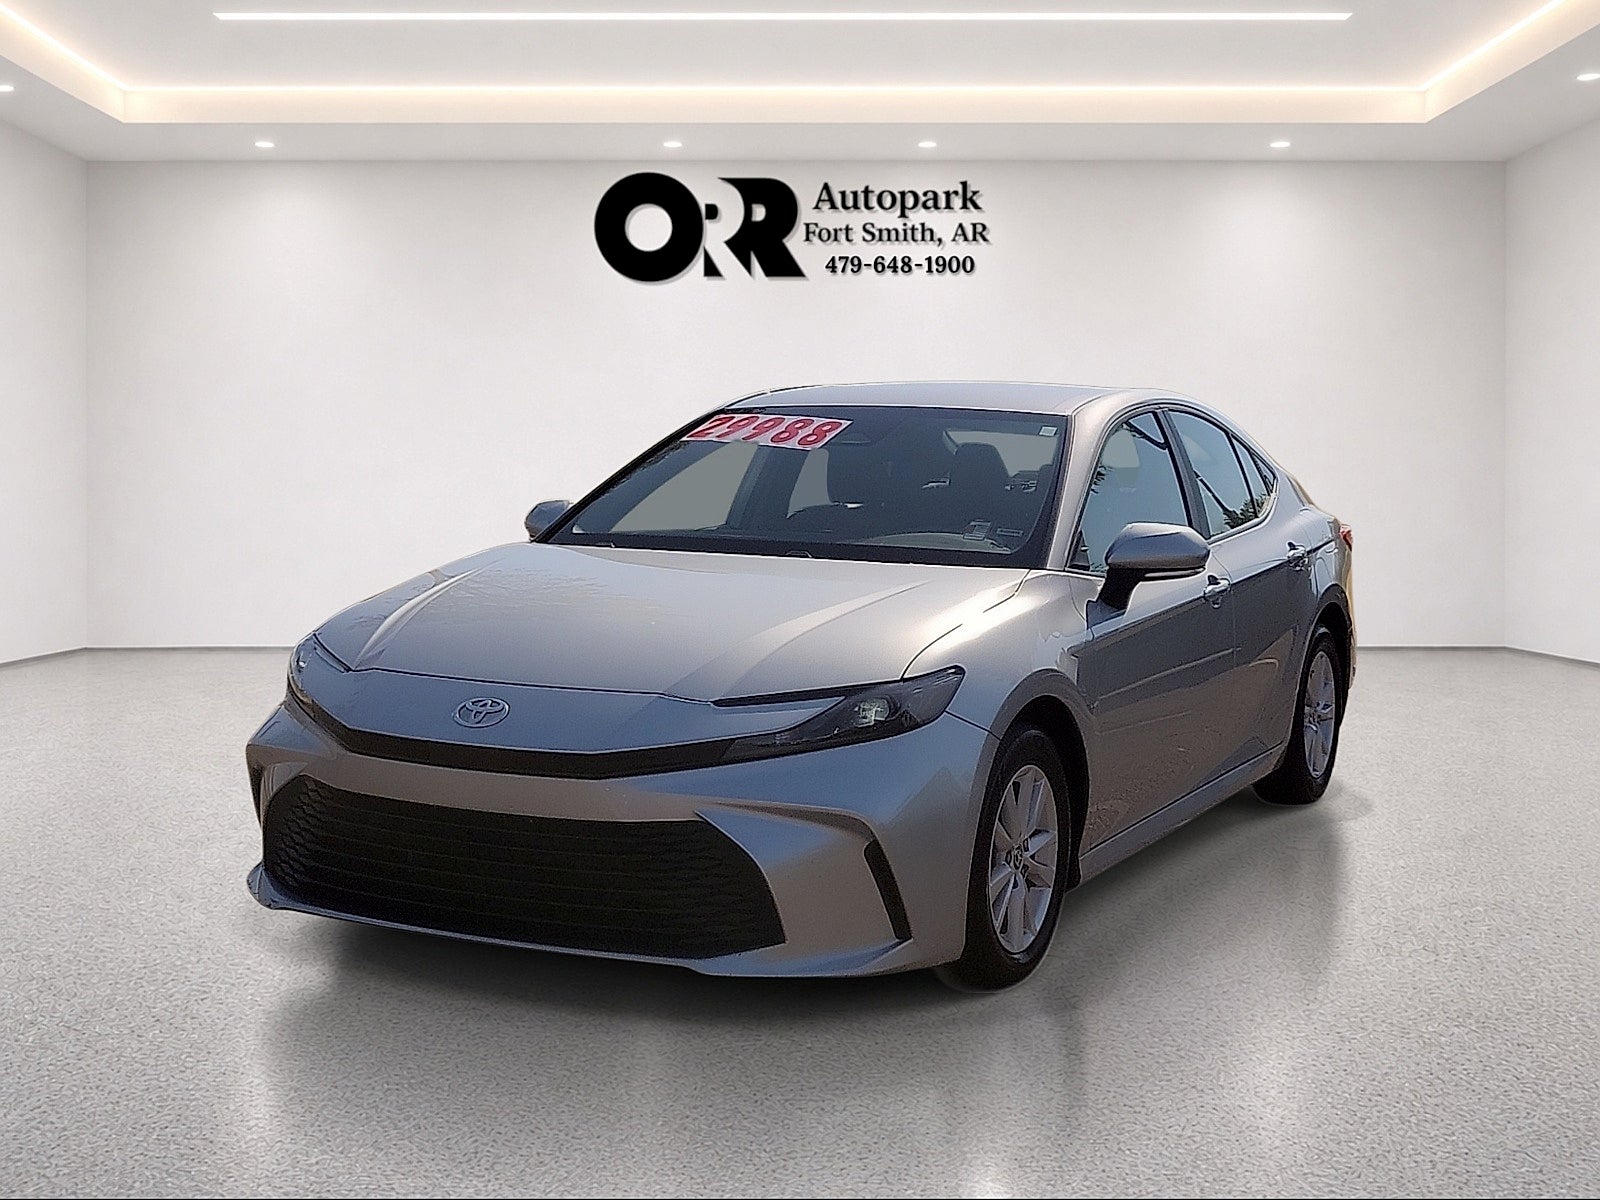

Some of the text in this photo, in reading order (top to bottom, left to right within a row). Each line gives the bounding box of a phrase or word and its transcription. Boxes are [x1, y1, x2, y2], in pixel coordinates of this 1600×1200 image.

[812, 180, 983, 218] Autopark
[594, 171, 806, 282] ORR
[803, 222, 990, 247] Fort Smith, AR
[824, 255, 976, 274] 479-648-1900
[686, 415, 843, 446] 29988
